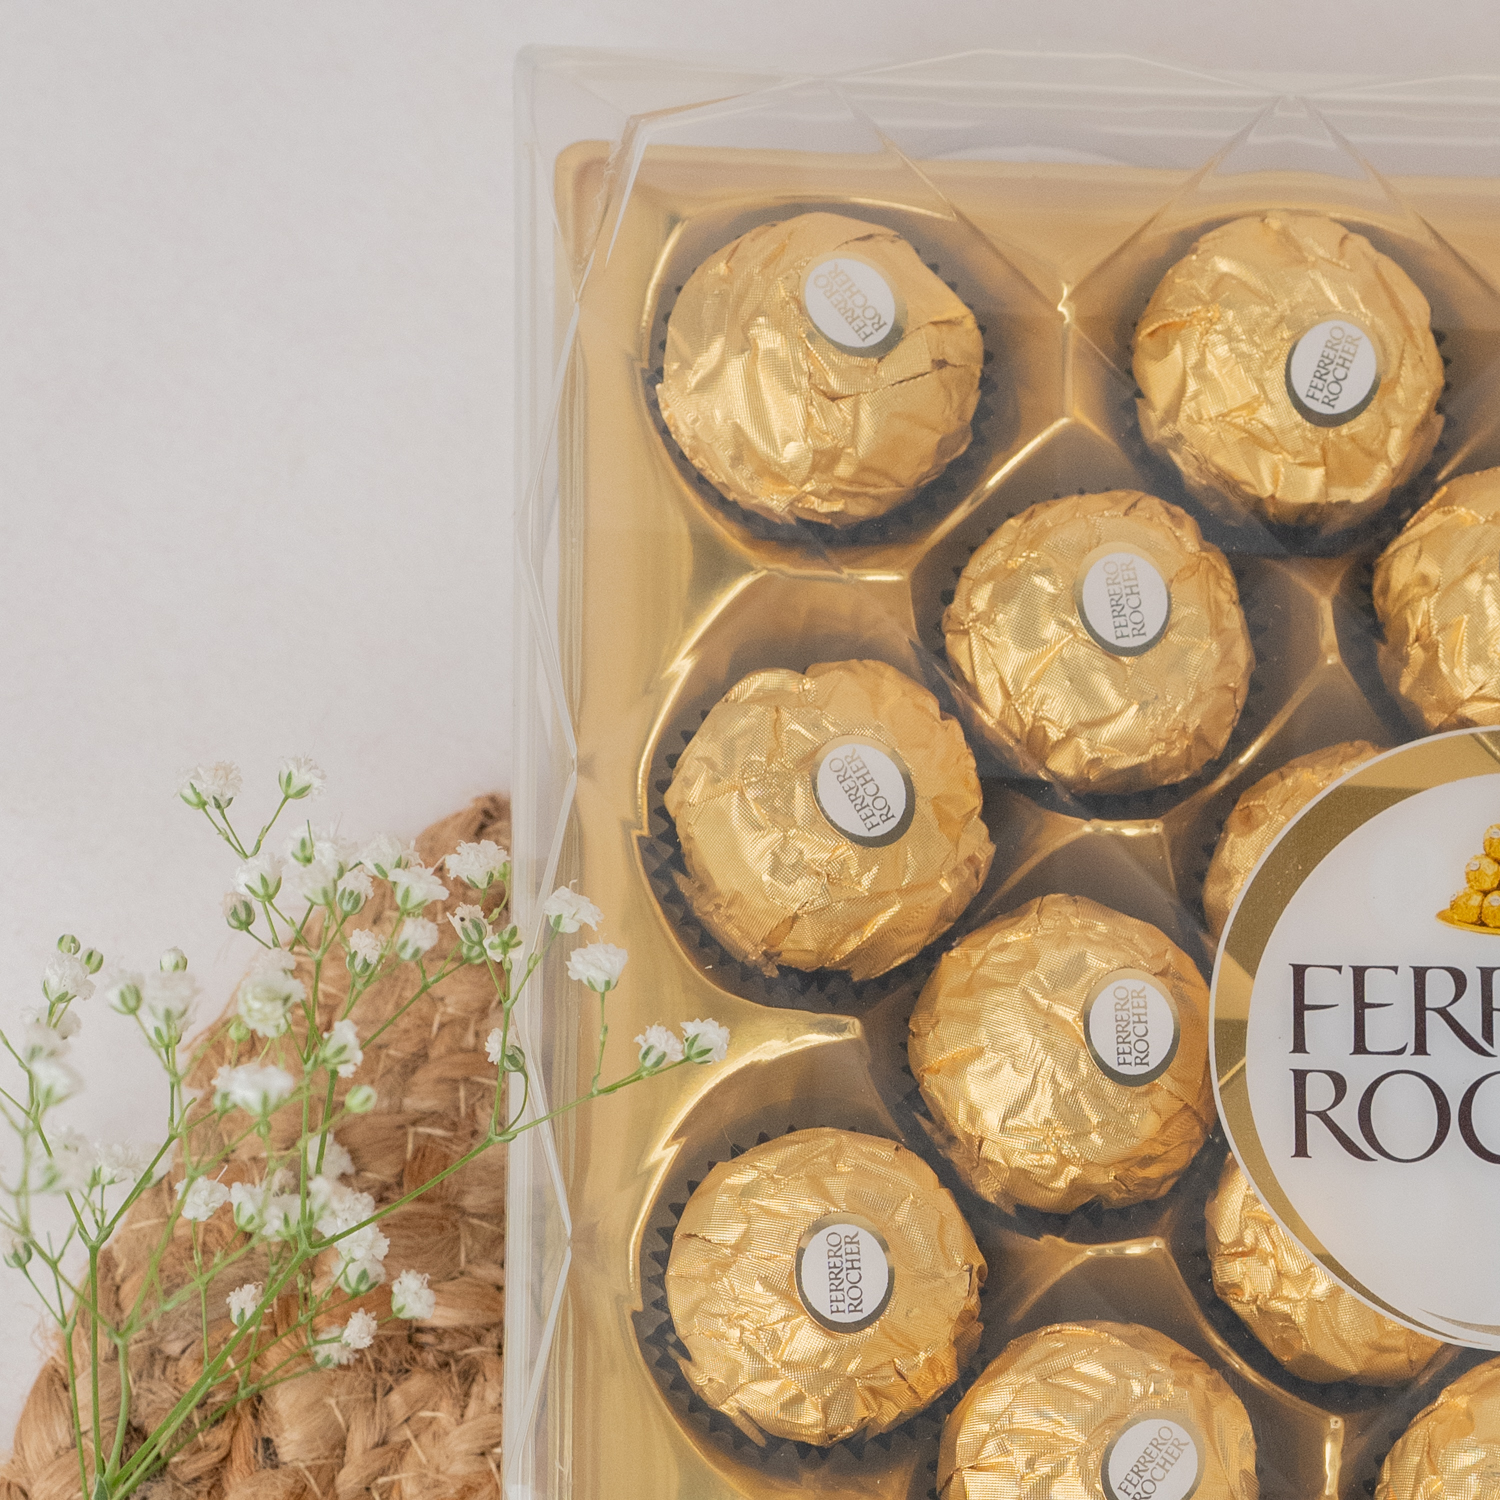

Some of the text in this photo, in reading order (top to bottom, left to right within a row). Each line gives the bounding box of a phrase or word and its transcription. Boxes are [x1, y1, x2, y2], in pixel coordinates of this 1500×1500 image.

[813, 273, 874, 342] FERRERO
[826, 263, 887, 333] ROCHER
[1305, 326, 1345, 402] FERRERO
[1320, 334, 1363, 409] ROCHER
[1102, 561, 1130, 641] FERRERO
[1120, 558, 1147, 638] ROCHER
[829, 757, 880, 832] FERRERO
[843, 748, 896, 825] ROCHER
[1113, 985, 1132, 1067] FERRERO
[1130, 985, 1150, 1067] ROCHER
[825, 1231, 845, 1315] FERRERO
[844, 1231, 863, 1314] ROCHER
[1117, 1426, 1173, 1497] FERRERO
